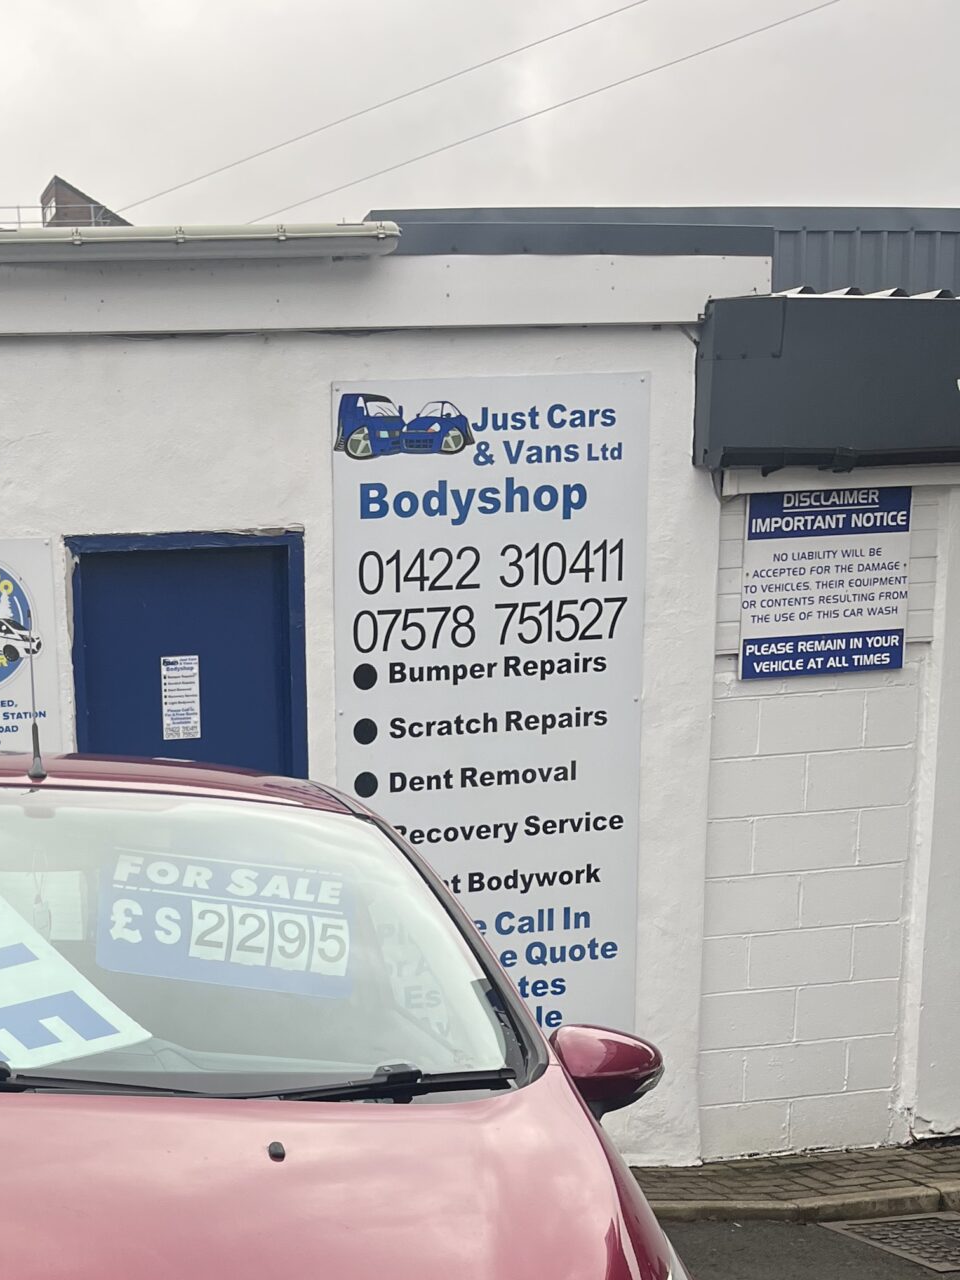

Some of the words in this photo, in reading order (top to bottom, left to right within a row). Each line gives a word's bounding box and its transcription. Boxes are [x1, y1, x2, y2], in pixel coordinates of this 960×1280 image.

[471, 405, 539, 432] Just
[546, 403, 617, 429] Cars
[473, 440, 495, 466] &
[503, 439, 579, 465] Vans
[587, 442, 623, 461] Ltd
[359, 477, 587, 526] Bodyshop
[783, 489, 879, 508] DISCLAIMER
[751, 514, 846, 533] IMPORTANT
[851, 511, 907, 528] NOTICE
[358, 546, 481, 595] 01422
[499, 538, 625, 588] 310411
[773, 552, 788, 562] NO
[792, 550, 838, 561] LIABILITY
[841, 548, 865, 559] WILL
[868, 547, 882, 557] BE
[752, 567, 806, 579] ACCEPTED
[810, 565, 831, 575] FOR
[834, 564, 853, 574] THE
[857, 561, 900, 572] DAMAGE
[744, 584, 757, 594] TO
[815, 580, 844, 590] THEIR
[848, 576, 908, 588] EQUIPMENT
[742, 599, 757, 610] OR
[760, 596, 815, 608] CONTENTS
[818, 592, 875, 605] RESULTING
[878, 591, 908, 601] FROM
[353, 605, 476, 653] 07578
[495, 596, 628, 645] 751527
[750, 614, 770, 624] THE
[774, 612, 795, 622] USE
[799, 611, 813, 621] OF
[817, 610, 839, 620] THIS
[843, 608, 863, 618] CAR
[867, 606, 898, 616] WASH
[746, 642, 793, 656] PLEASE
[797, 638, 846, 653] REMAIN
[850, 637, 862, 648] IN
[866, 635, 900, 647] YOUR
[389, 661, 497, 685] Bumper
[503, 652, 607, 680] Repairs
[753, 659, 804, 673] VEHICLE
[807, 658, 824, 669] AT
[826, 656, 849, 667] ALL
[852, 653, 890, 666] TIMES
[2, 710, 47, 720] STATION
[389, 713, 498, 739] Scratch
[505, 707, 608, 735] Repairs
[390, 769, 453, 793] Dent
[460, 760, 577, 788] Removal
[524, 812, 624, 836] Service
[113, 854, 213, 890] FOR
[226, 868, 343, 905] SALE
[468, 864, 602, 894] Bodywork
[194, 908, 346, 963] 2295
[494, 908, 554, 936] Call
[563, 907, 591, 930] In
[525, 937, 618, 967] Quote
